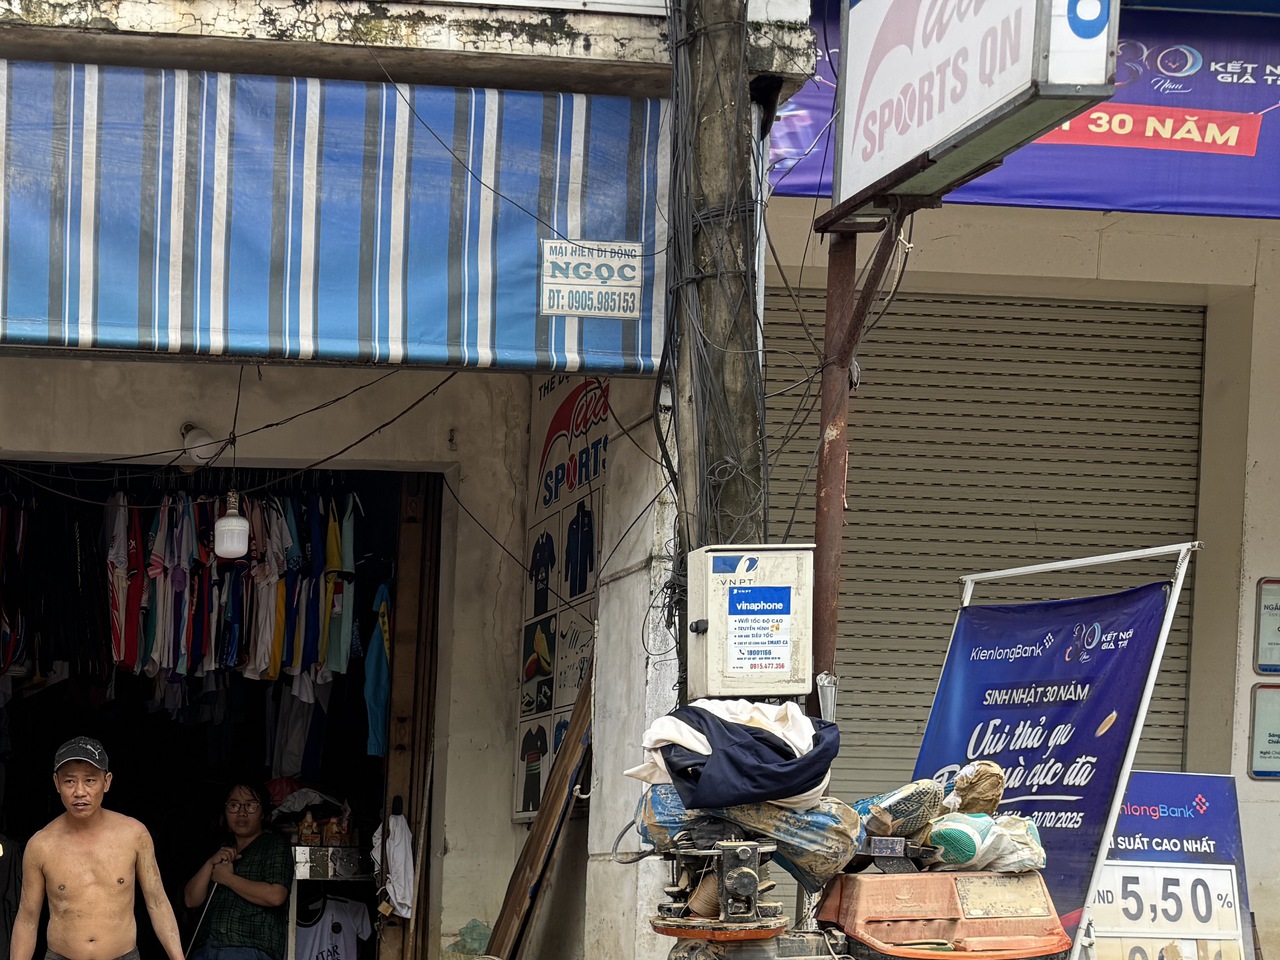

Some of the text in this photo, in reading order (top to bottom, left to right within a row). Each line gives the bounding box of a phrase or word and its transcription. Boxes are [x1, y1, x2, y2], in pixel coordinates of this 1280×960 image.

[979, 8, 1022, 88] QN
[1210, 60, 1258, 73] KẾT
[1088, 112, 1134, 135] 30
[1145, 115, 1240, 146] NĂM
[549, 261, 637, 284] NGỌC
[548, 289, 636, 313] ĐT: 0905.985153
[736, 601, 783, 611] vinaphone
[970, 643, 1044, 662] KienlongBank
[983, 681, 1090, 707] SINH NHẬT 30 NĂM
[966, 718, 1010, 760] Vui
[1009, 716, 1048, 751] thả
[1063, 754, 1098, 787] đã
[1119, 801, 1195, 820] nlongBank
[1117, 833, 1149, 851] SUẤT
[1152, 837, 1181, 852] CAO
[1183, 836, 1216, 853] NHẤT
[1121, 875, 1213, 923] 5,50
[1216, 893, 1233, 909] %
